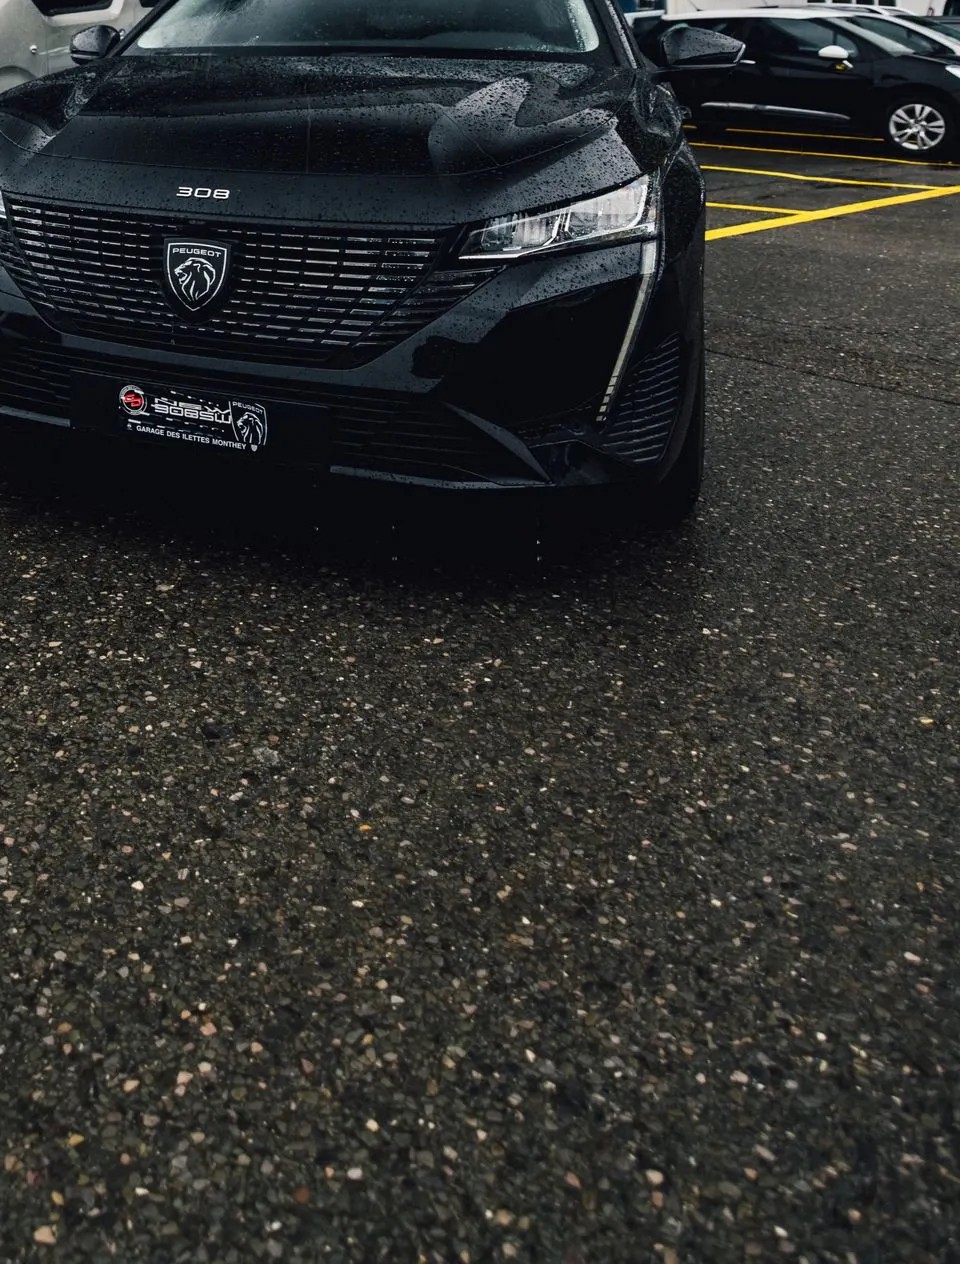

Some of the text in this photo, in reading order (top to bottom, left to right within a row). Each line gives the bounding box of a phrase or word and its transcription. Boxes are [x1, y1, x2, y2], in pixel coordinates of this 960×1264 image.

[175, 186, 231, 200] 308
[172, 247, 222, 258] PEUGEOT
[232, 401, 263, 415] PEUGEOT
[136, 425, 247, 450] GARAGE DES ILETTES MONTHEY
